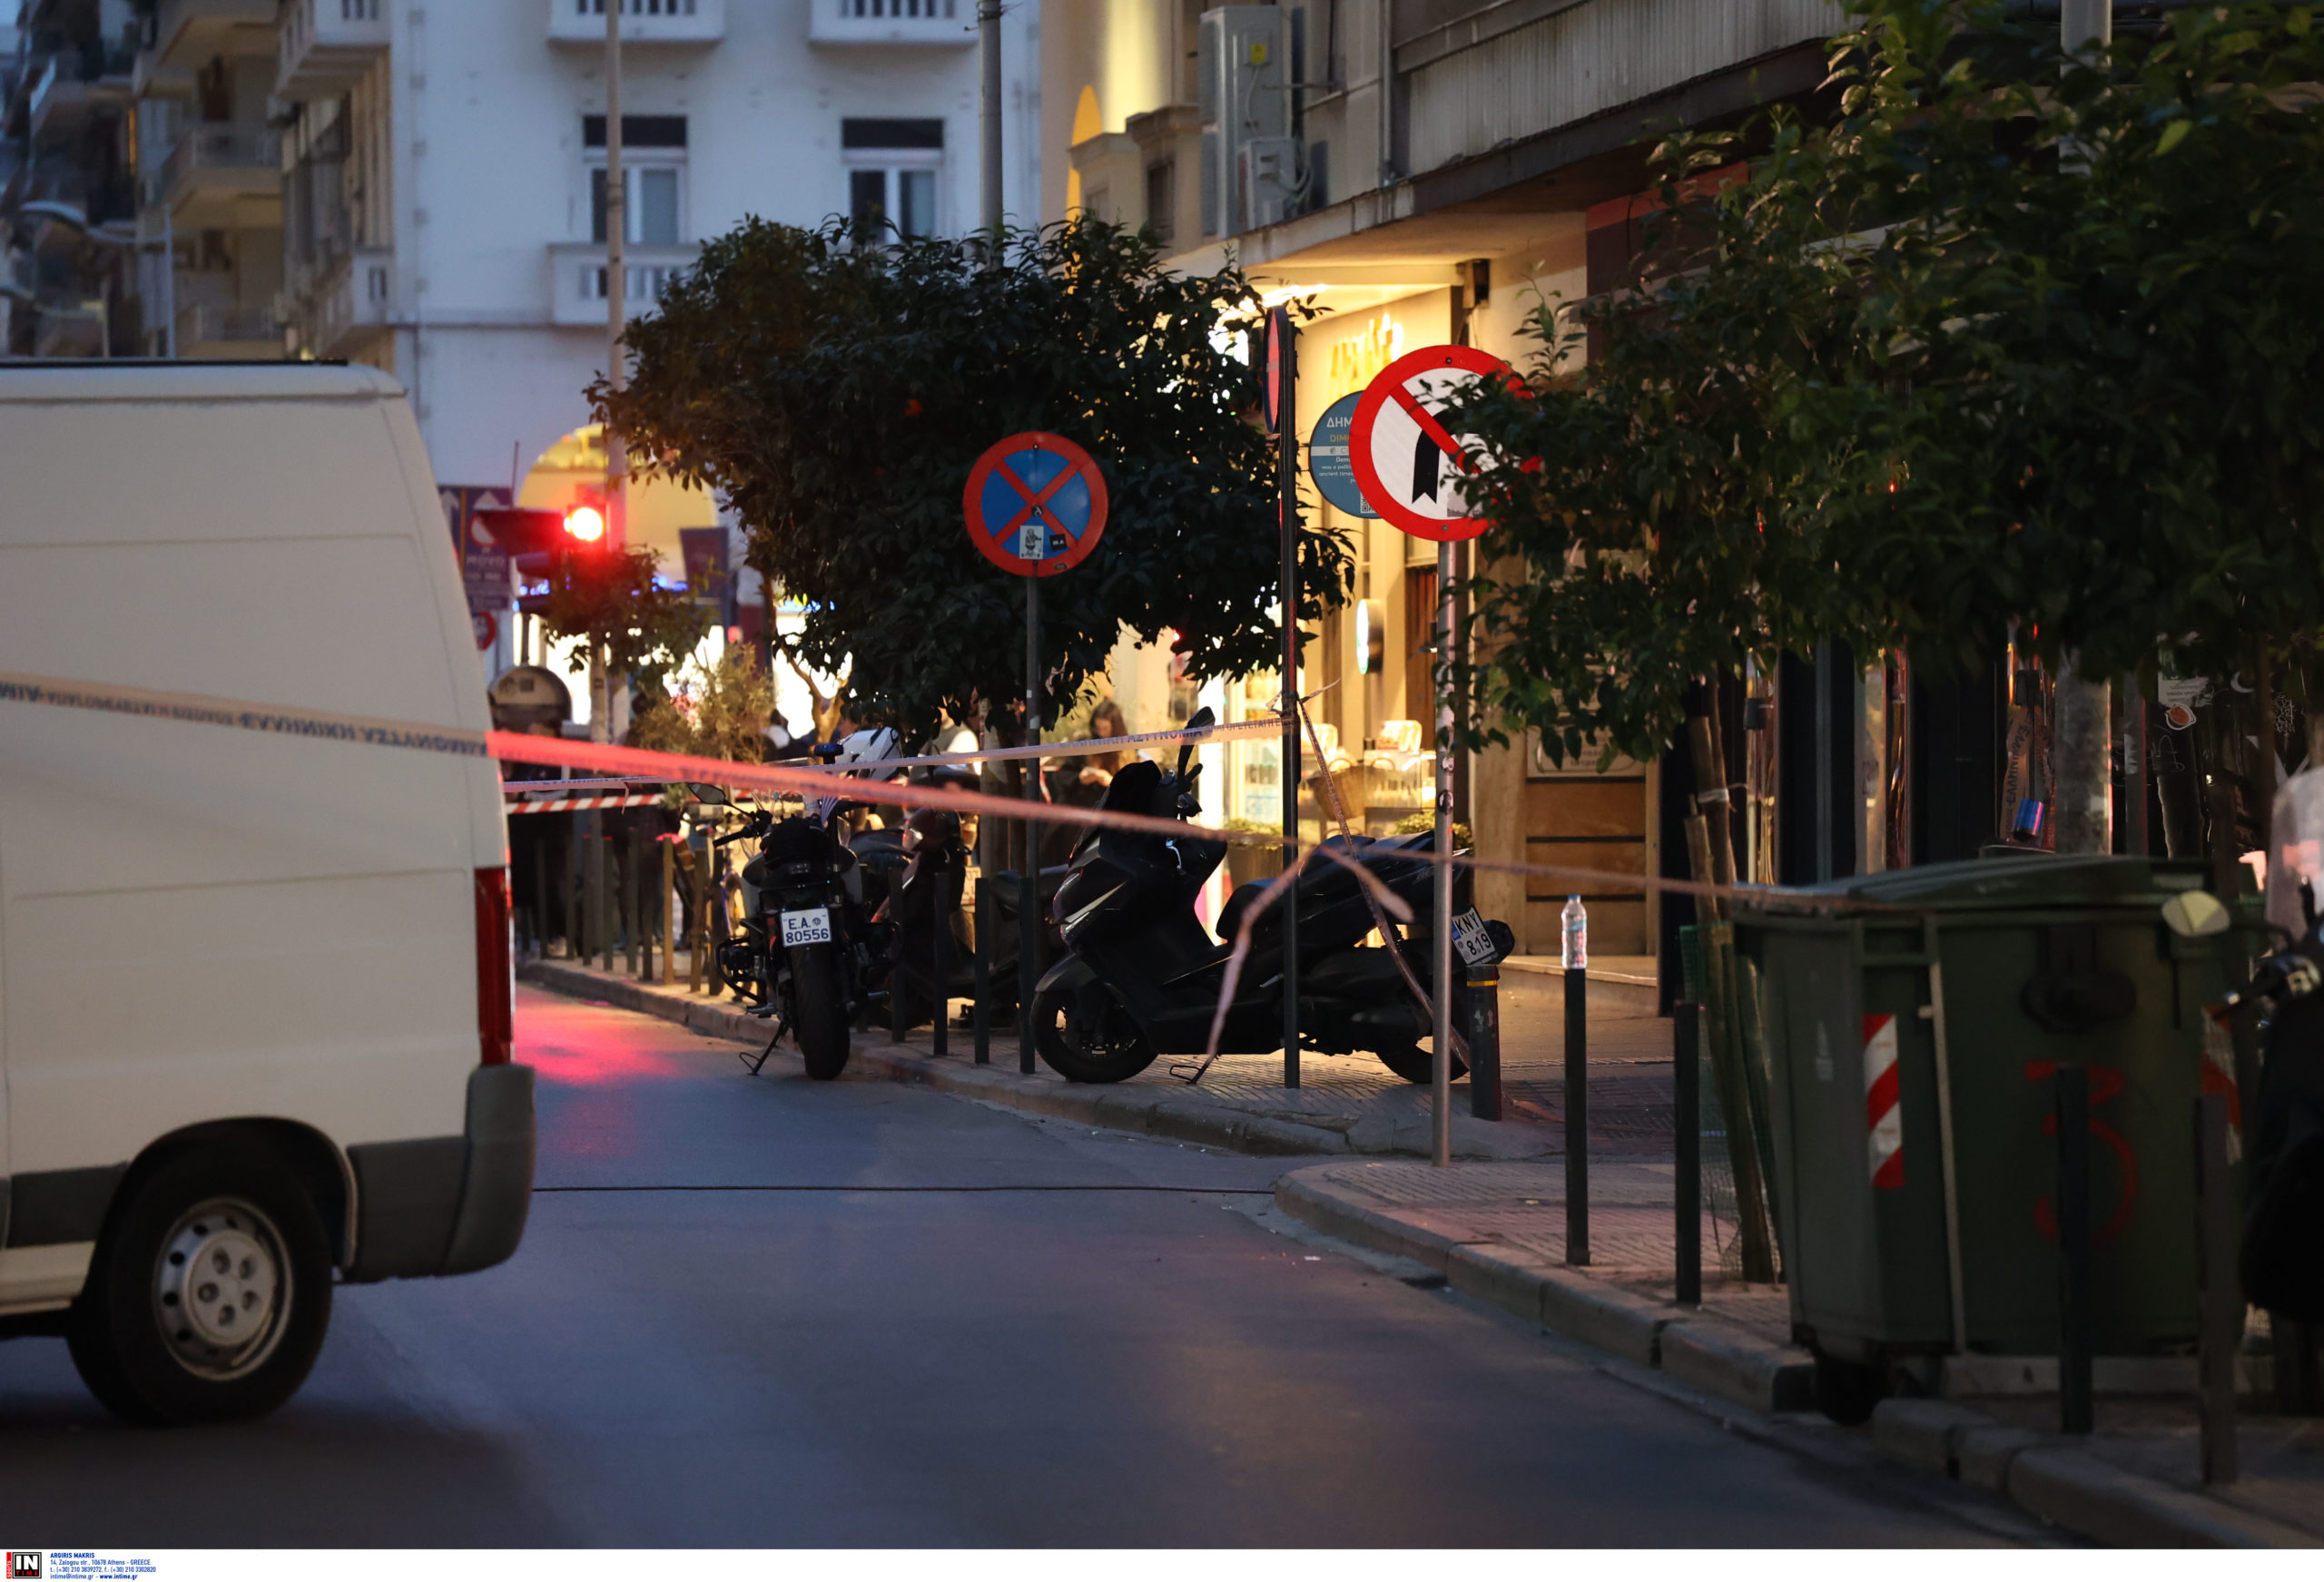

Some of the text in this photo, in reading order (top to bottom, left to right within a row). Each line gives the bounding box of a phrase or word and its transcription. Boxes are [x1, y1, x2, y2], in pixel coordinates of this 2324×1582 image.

[1326, 417, 1353, 428] ΔΗΜ
[1330, 434, 1350, 443] DIM
[1454, 912, 1479, 935] KNY
[785, 929, 829, 943] 80556
[1466, 934, 1491, 955] 819
